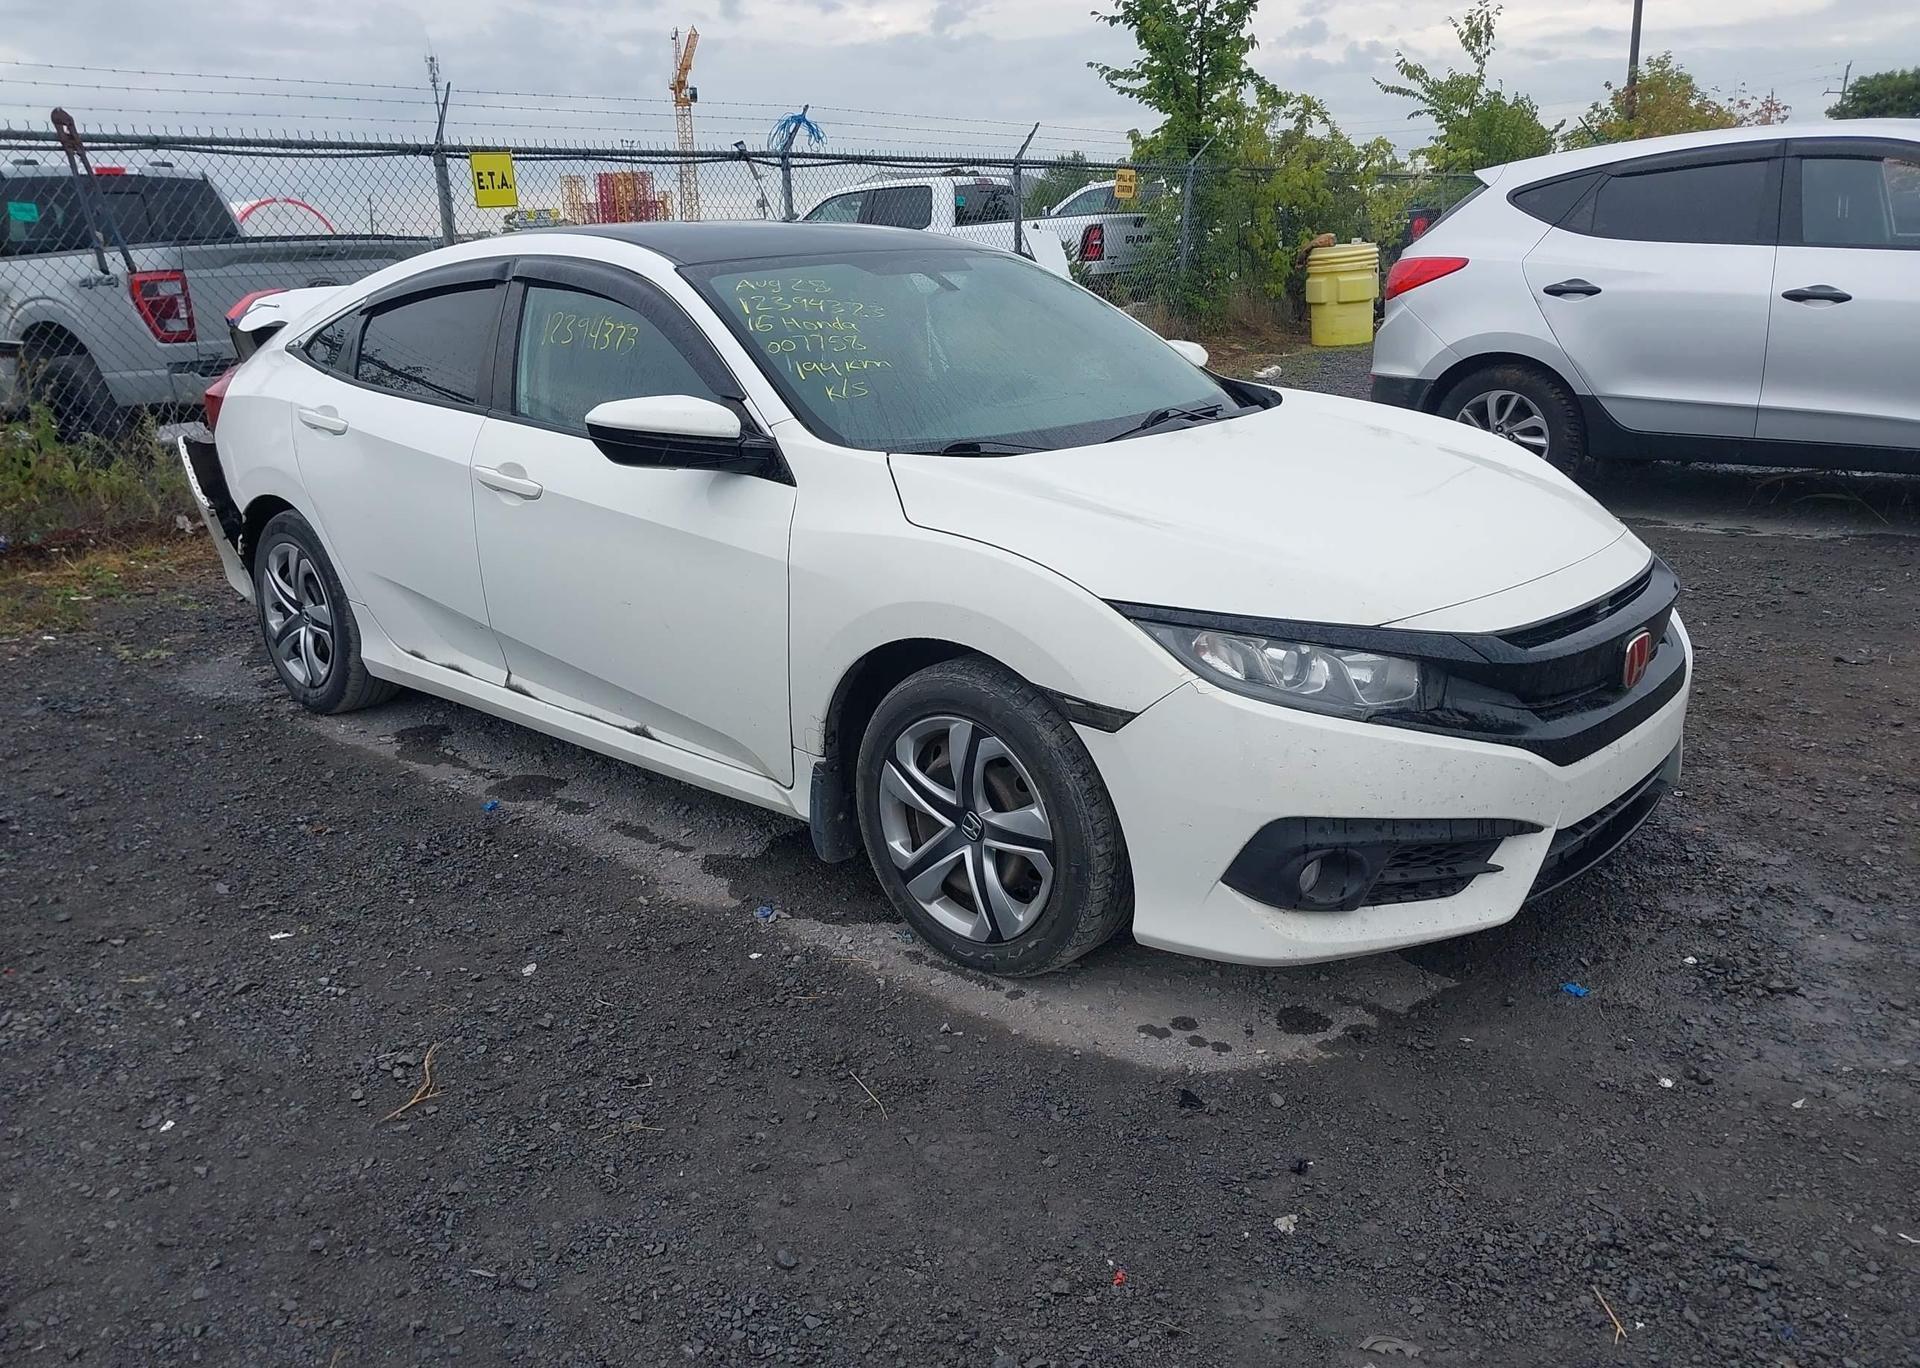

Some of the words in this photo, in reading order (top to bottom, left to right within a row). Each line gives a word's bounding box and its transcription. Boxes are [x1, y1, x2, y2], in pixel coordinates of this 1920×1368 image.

[476, 171, 513, 190] E.T.A.
[735, 279, 781, 293] Aug
[790, 278, 832, 293] 28
[748, 314, 774, 332] 16
[780, 316, 861, 332] Honda
[767, 334, 868, 354] 007758
